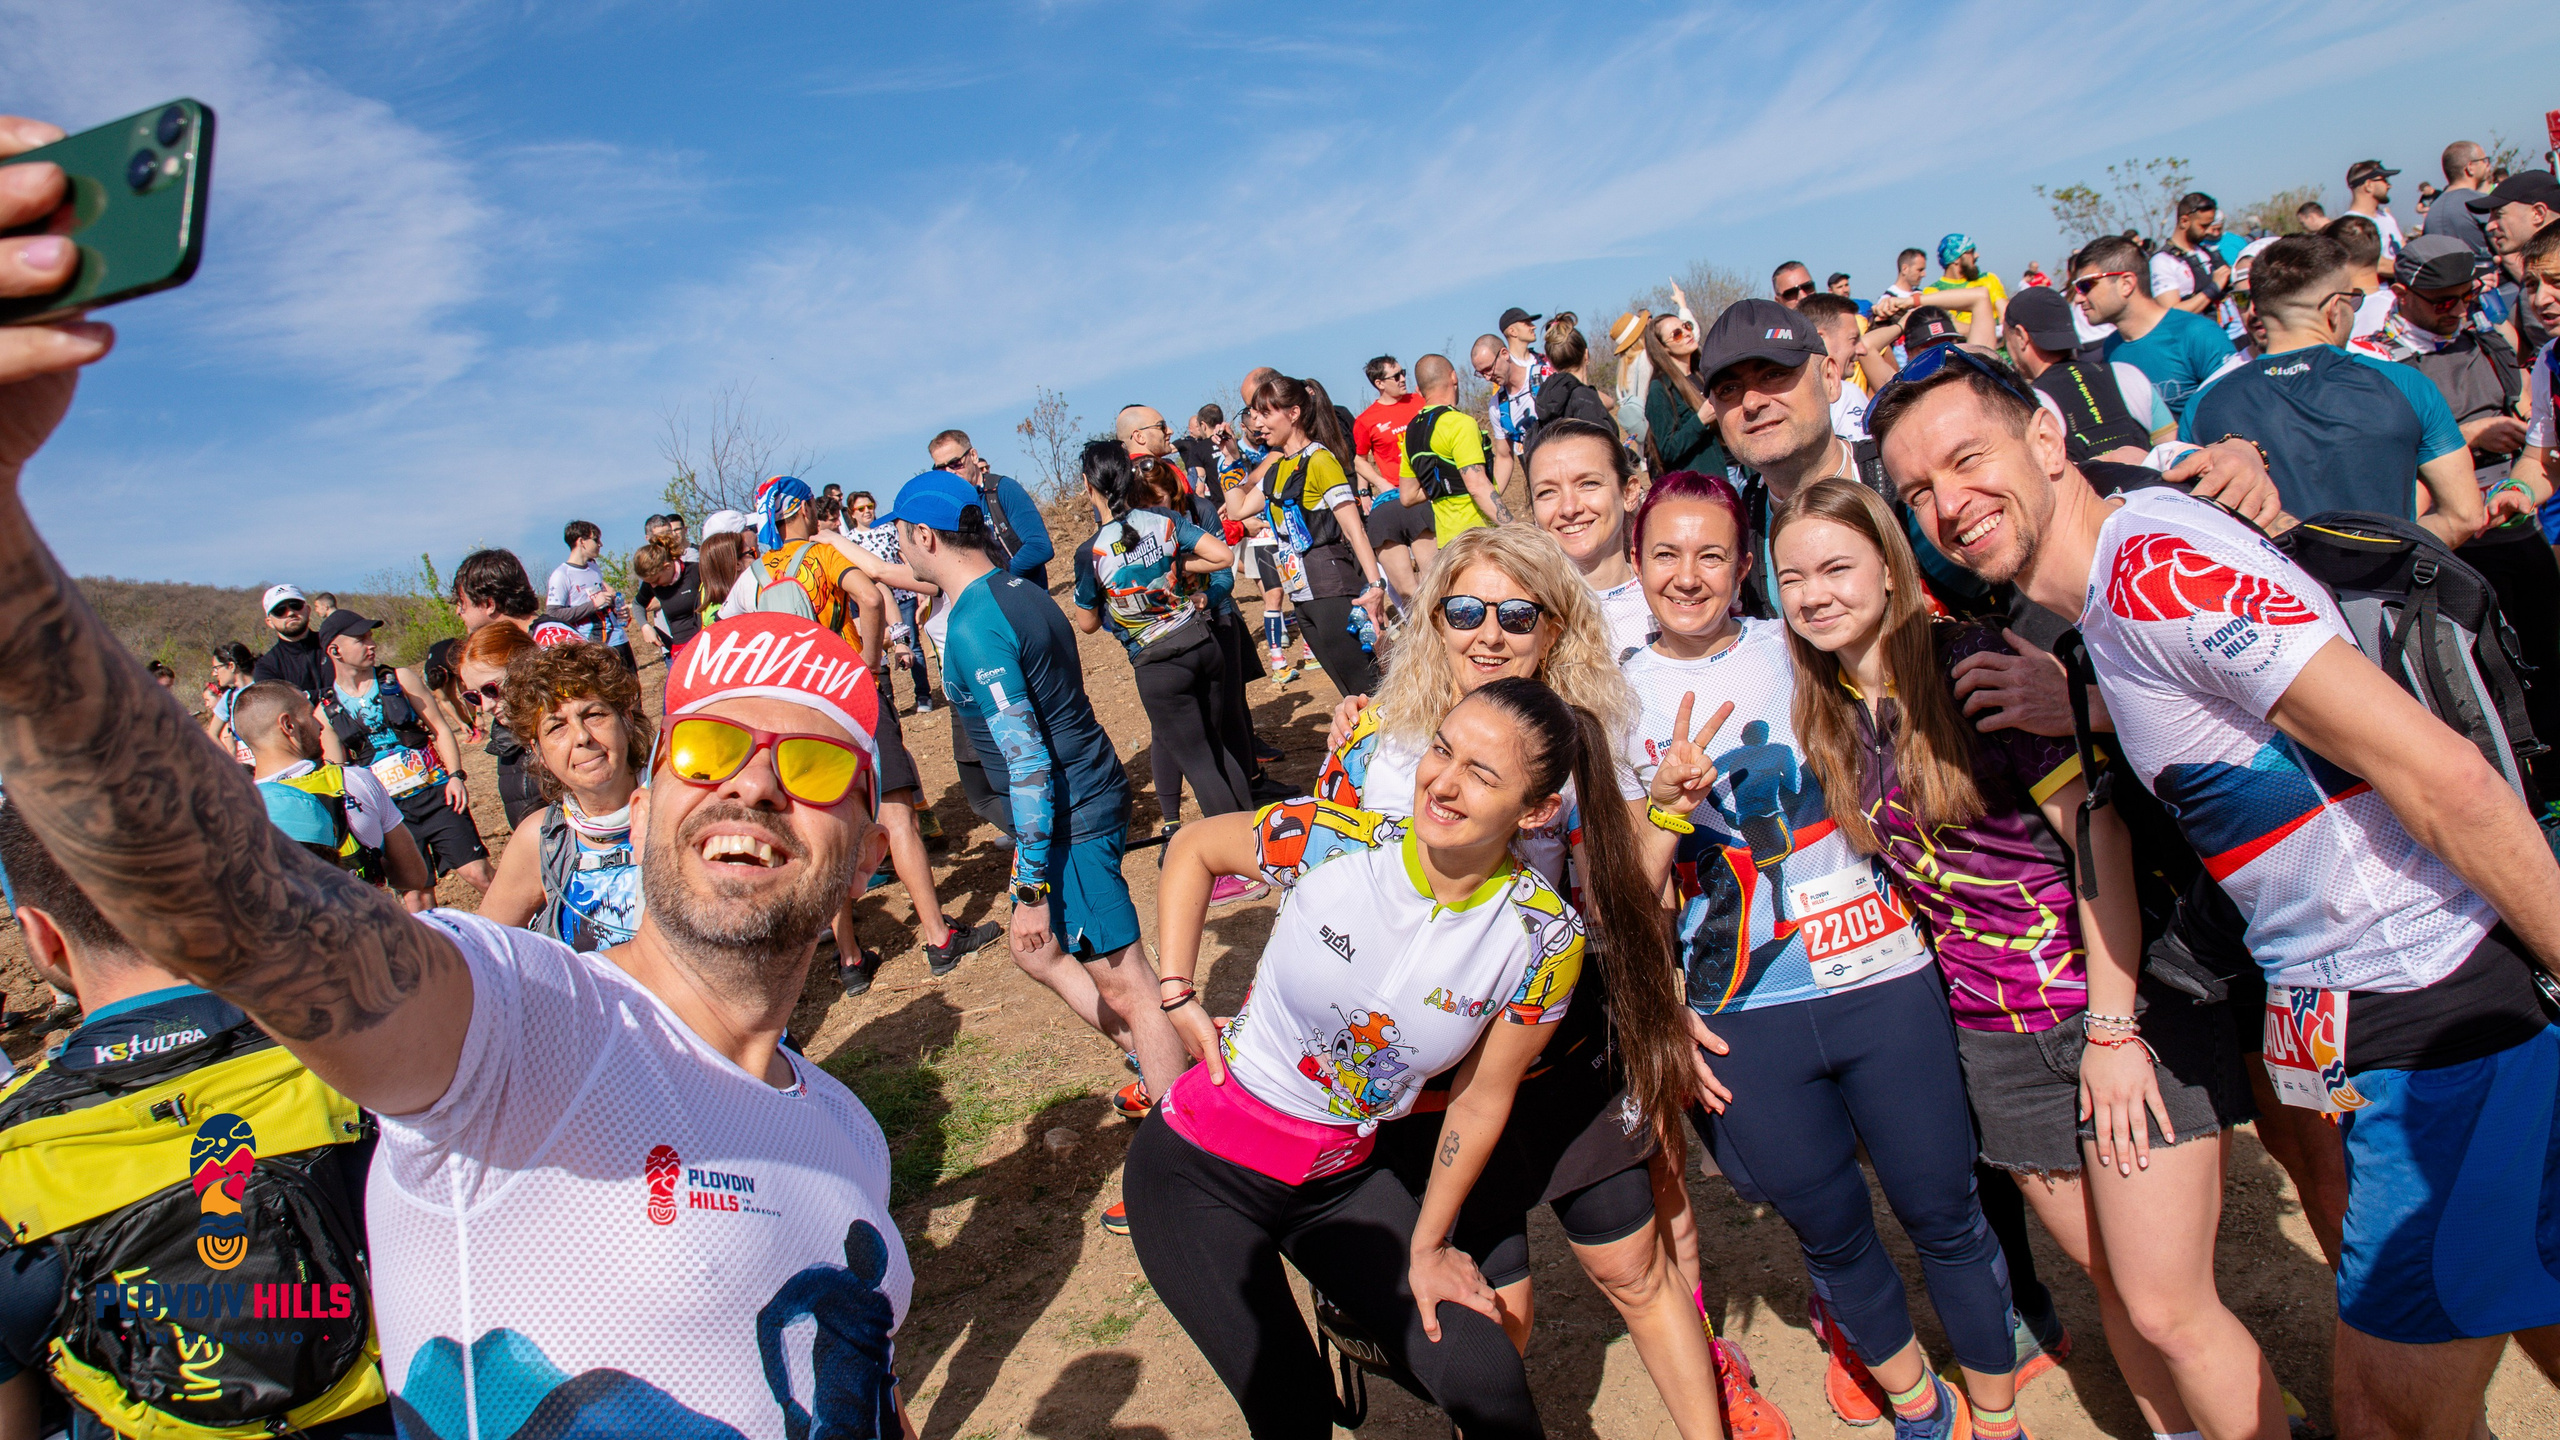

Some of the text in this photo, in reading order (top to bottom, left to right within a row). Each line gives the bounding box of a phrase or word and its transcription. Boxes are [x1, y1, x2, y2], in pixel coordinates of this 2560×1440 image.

[2078, 382, 2095, 407] sports
[2089, 406, 2104, 424] gear
[1143, 547, 1163, 568] RACE
[2201, 612, 2255, 653] PLOVDIV
[2221, 628, 2259, 660] HILLS
[2223, 632, 2283, 678] TRAIL RUN RACE
[379, 766, 406, 786] 258
[1804, 898, 1885, 957] 2209
[142, 1028, 208, 1054] ULTRA
[2264, 1010, 2301, 1063] 404
[688, 1168, 755, 1194] PLOVDIV
[689, 1190, 740, 1213] HILLS
[743, 1206, 782, 1218] MARKOVO
